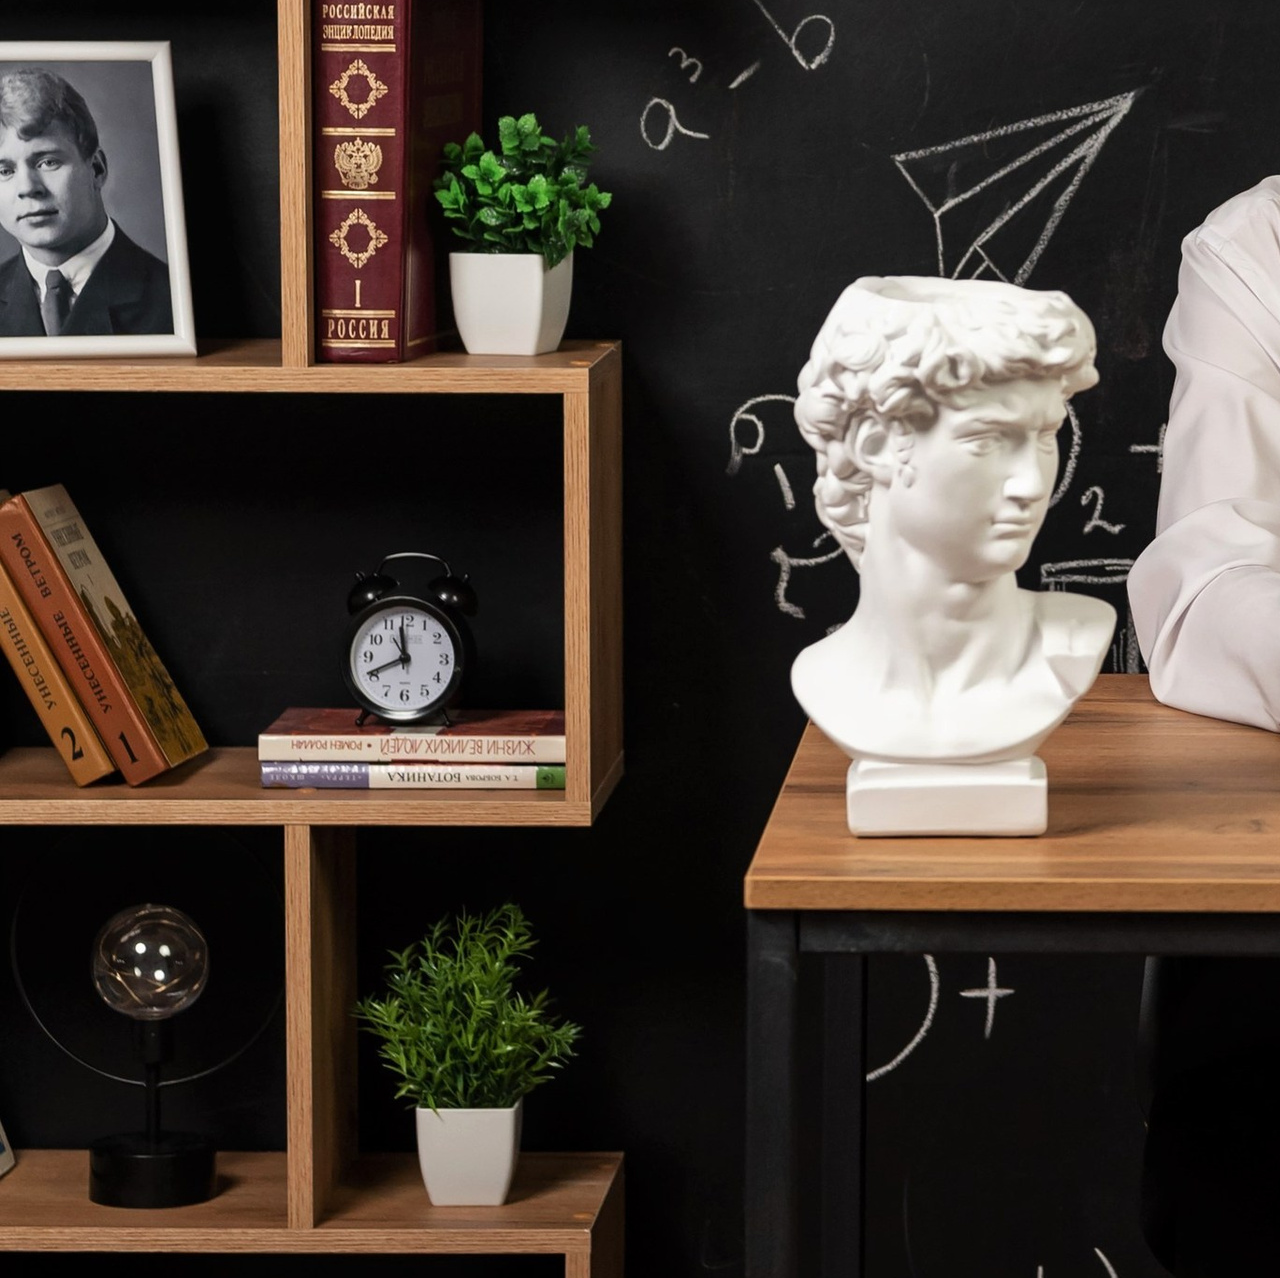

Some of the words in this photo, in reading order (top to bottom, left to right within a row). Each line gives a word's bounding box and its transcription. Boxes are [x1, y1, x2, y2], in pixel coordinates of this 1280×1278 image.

[322, 2, 395, 19] РОССИЙСКАЯ
[322, 23, 395, 41] ЭНЦИКЛОПЕДИЯ
[326, 318, 390, 340] РОССИЯ
[10, 532, 52, 599] ВЕТРОМ
[383, 618, 394, 631] 11
[422, 619, 427, 631] 1
[369, 633, 383, 646] 10
[432, 632, 442, 645] 2
[0, 606, 57, 711] УНЕСЕННЫЕ
[53, 610, 113, 714] УНЕСЕННЫЕ
[363, 650, 373, 664] 9
[439, 653, 450, 666] 3
[432, 671, 441, 684] 4
[382, 684, 391, 698] 7
[399, 689, 410, 702] 6
[420, 684, 430, 698] 5
[60, 725, 85, 762] 2
[117, 731, 141, 765] 1
[290, 739, 329, 751] РОЛЛАН
[330, 739, 363, 751] РОМЕН
[379, 737, 425, 757] ЛЮДЕЙ
[424, 738, 483, 756] ВЕЛИКИХ
[486, 738, 536, 756] ЖИЗНИ
[387, 771, 461, 783] БОТАНИКА
[465, 774, 502, 782] БОБРОВА
